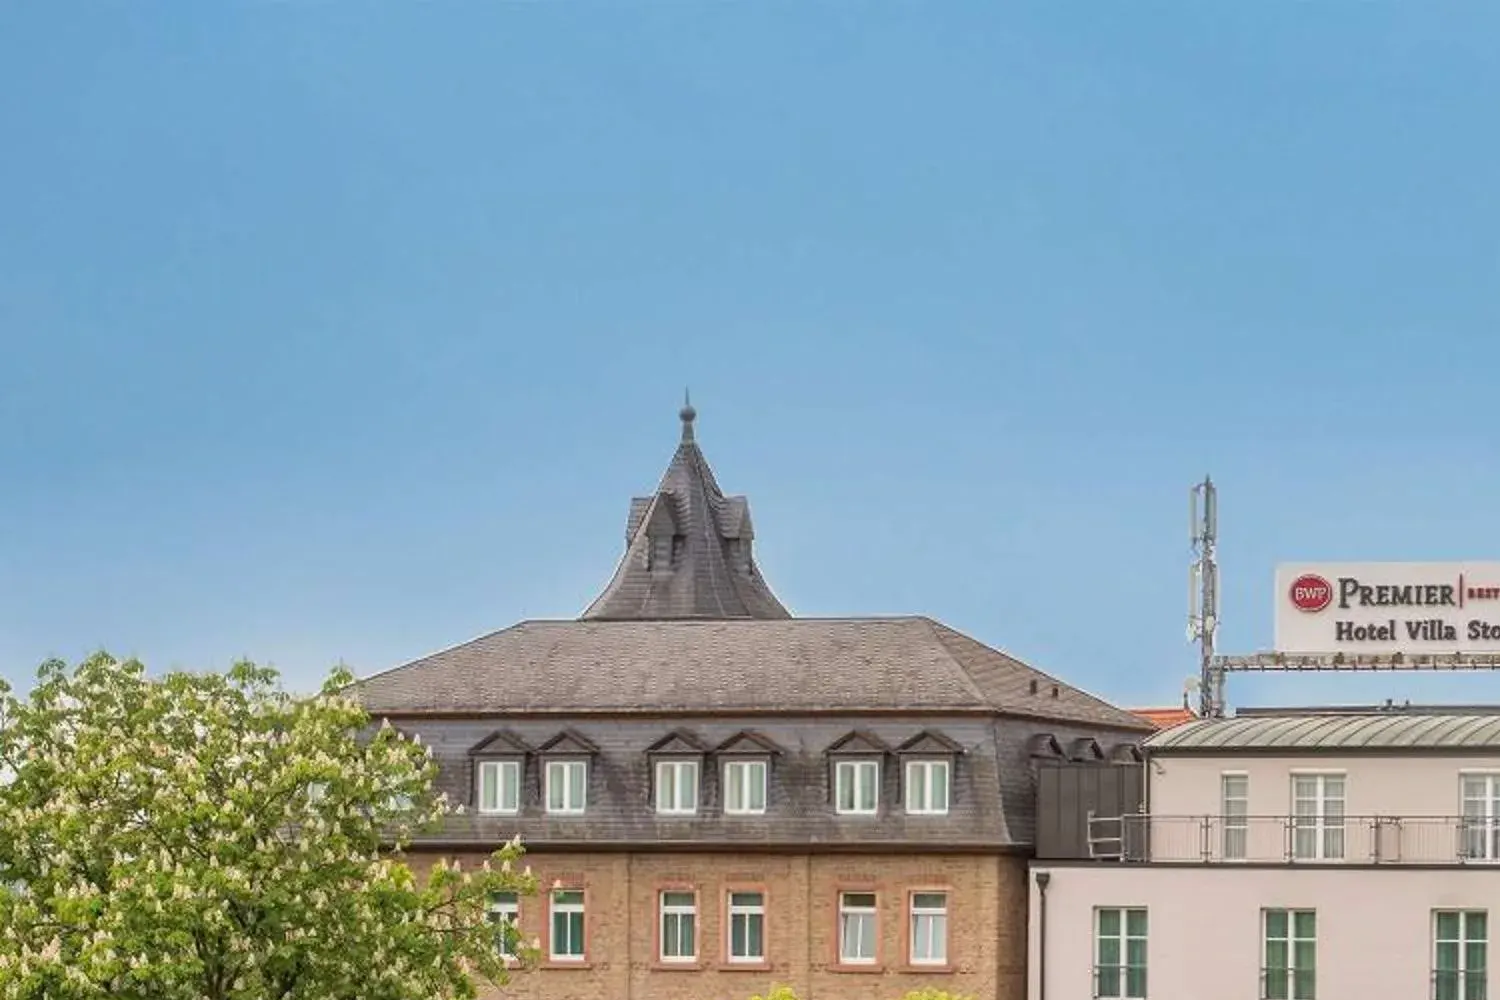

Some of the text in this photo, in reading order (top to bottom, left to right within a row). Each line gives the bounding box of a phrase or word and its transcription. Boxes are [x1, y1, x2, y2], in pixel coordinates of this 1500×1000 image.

[1295, 587, 1327, 600] BWP
[1338, 577, 1455, 608] PREMIER
[1467, 587, 1500, 599] BEST
[1336, 620, 1396, 641] Hotel
[1405, 619, 1457, 641] Villa
